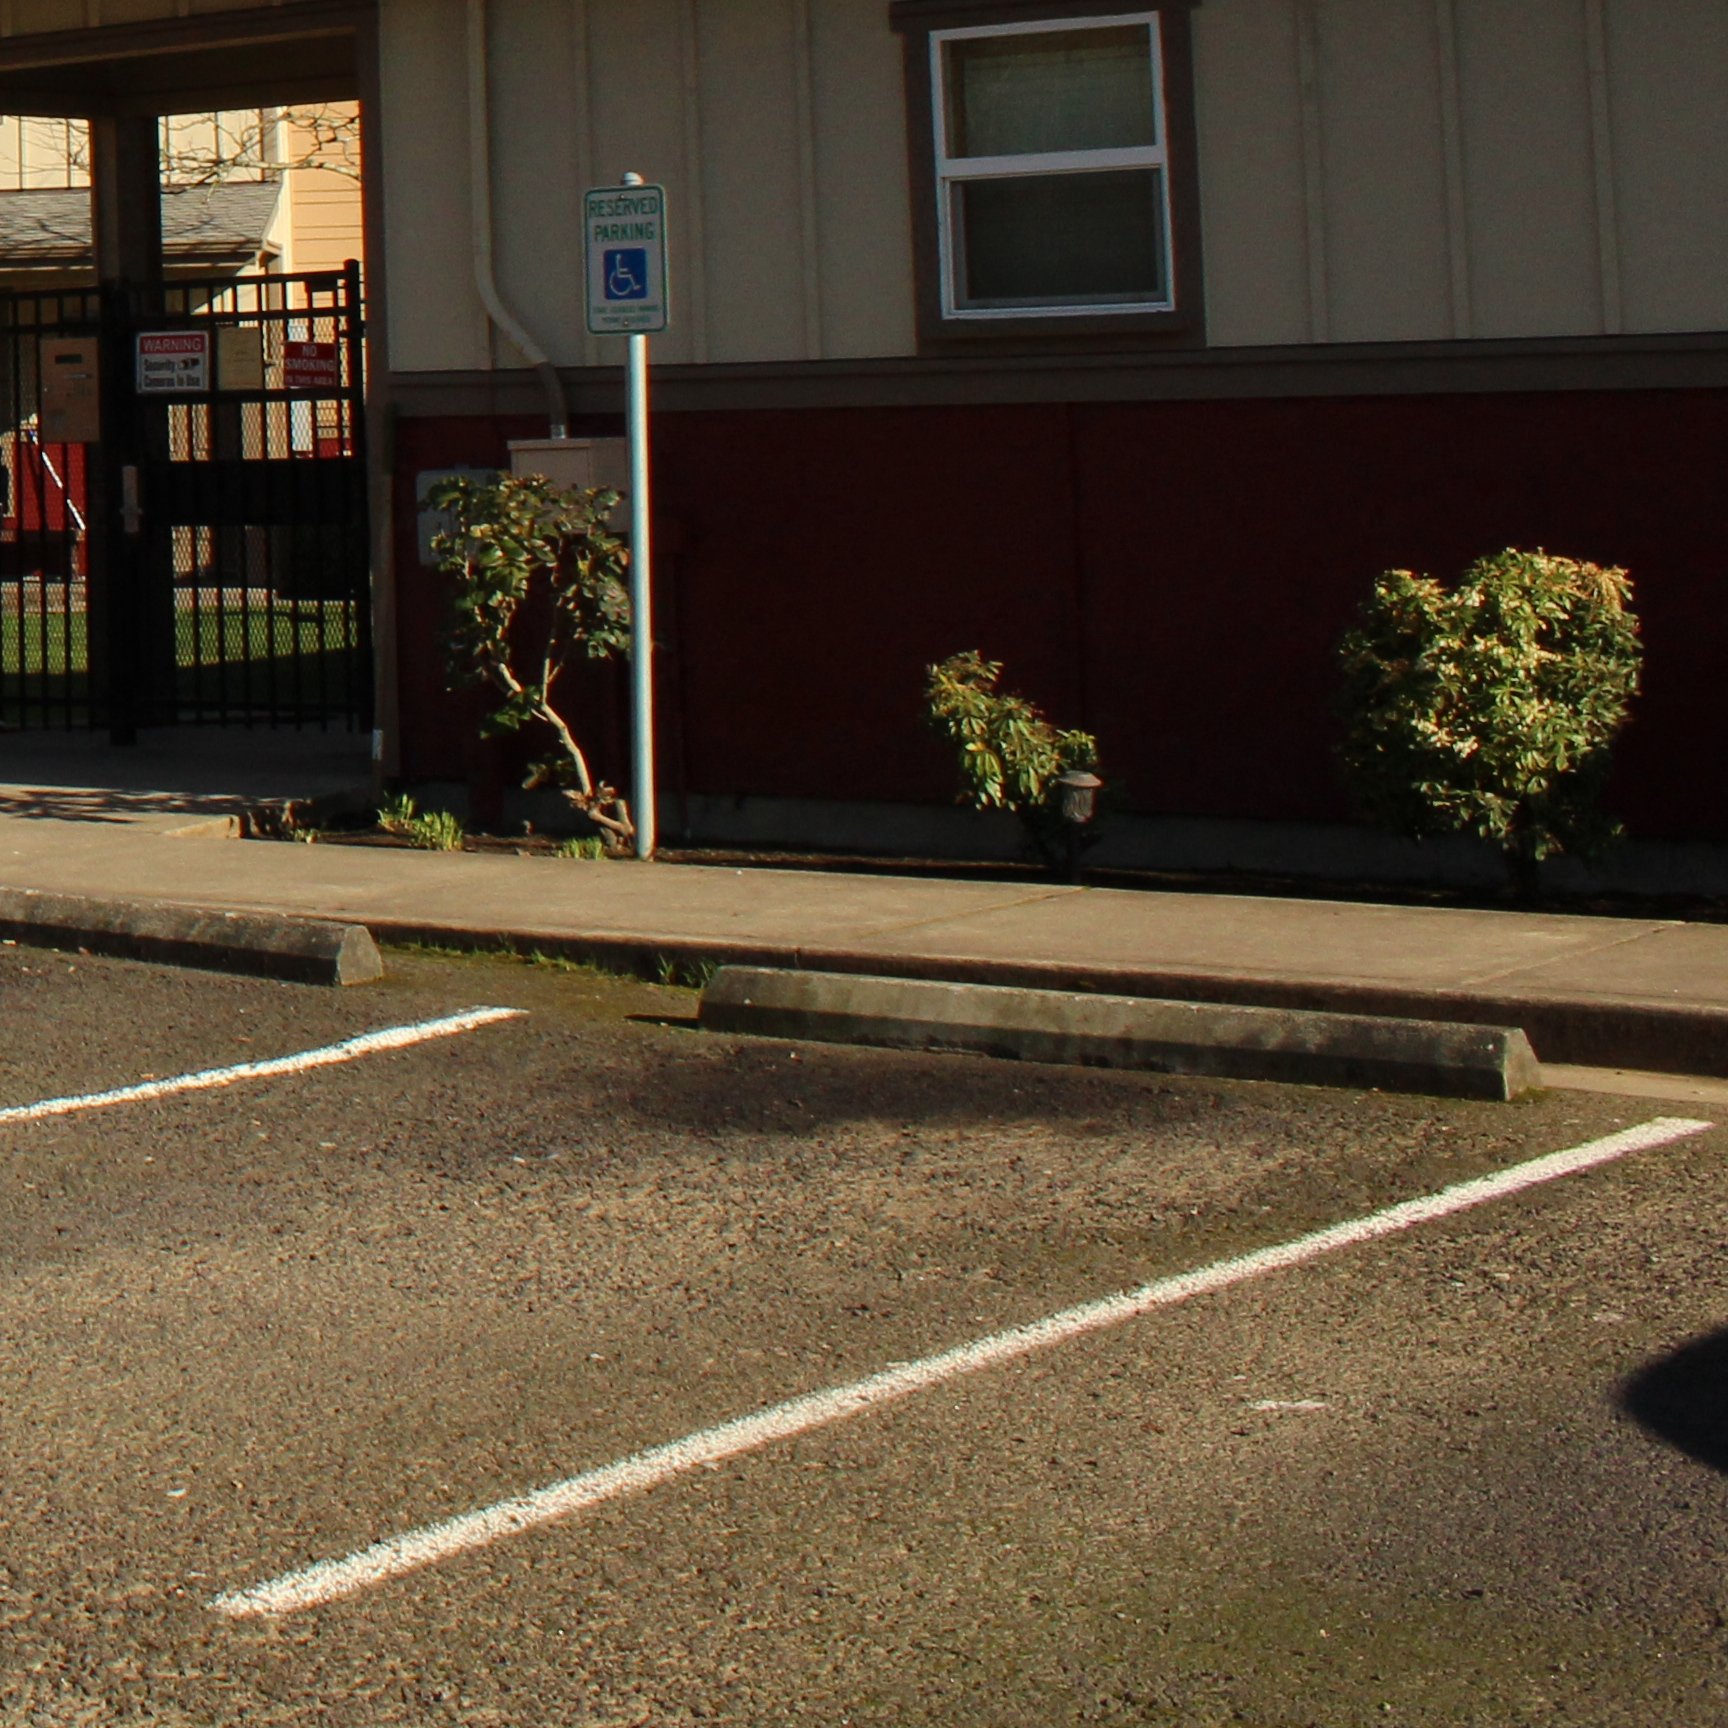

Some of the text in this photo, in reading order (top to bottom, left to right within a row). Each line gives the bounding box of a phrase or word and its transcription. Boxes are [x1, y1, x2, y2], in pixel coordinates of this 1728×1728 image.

[588, 196, 658, 217] RESERVED
[594, 222, 656, 242] PARKING
[143, 337, 202, 351] WARNING
[303, 344, 317, 357] NO
[286, 358, 336, 371] SMOKING
